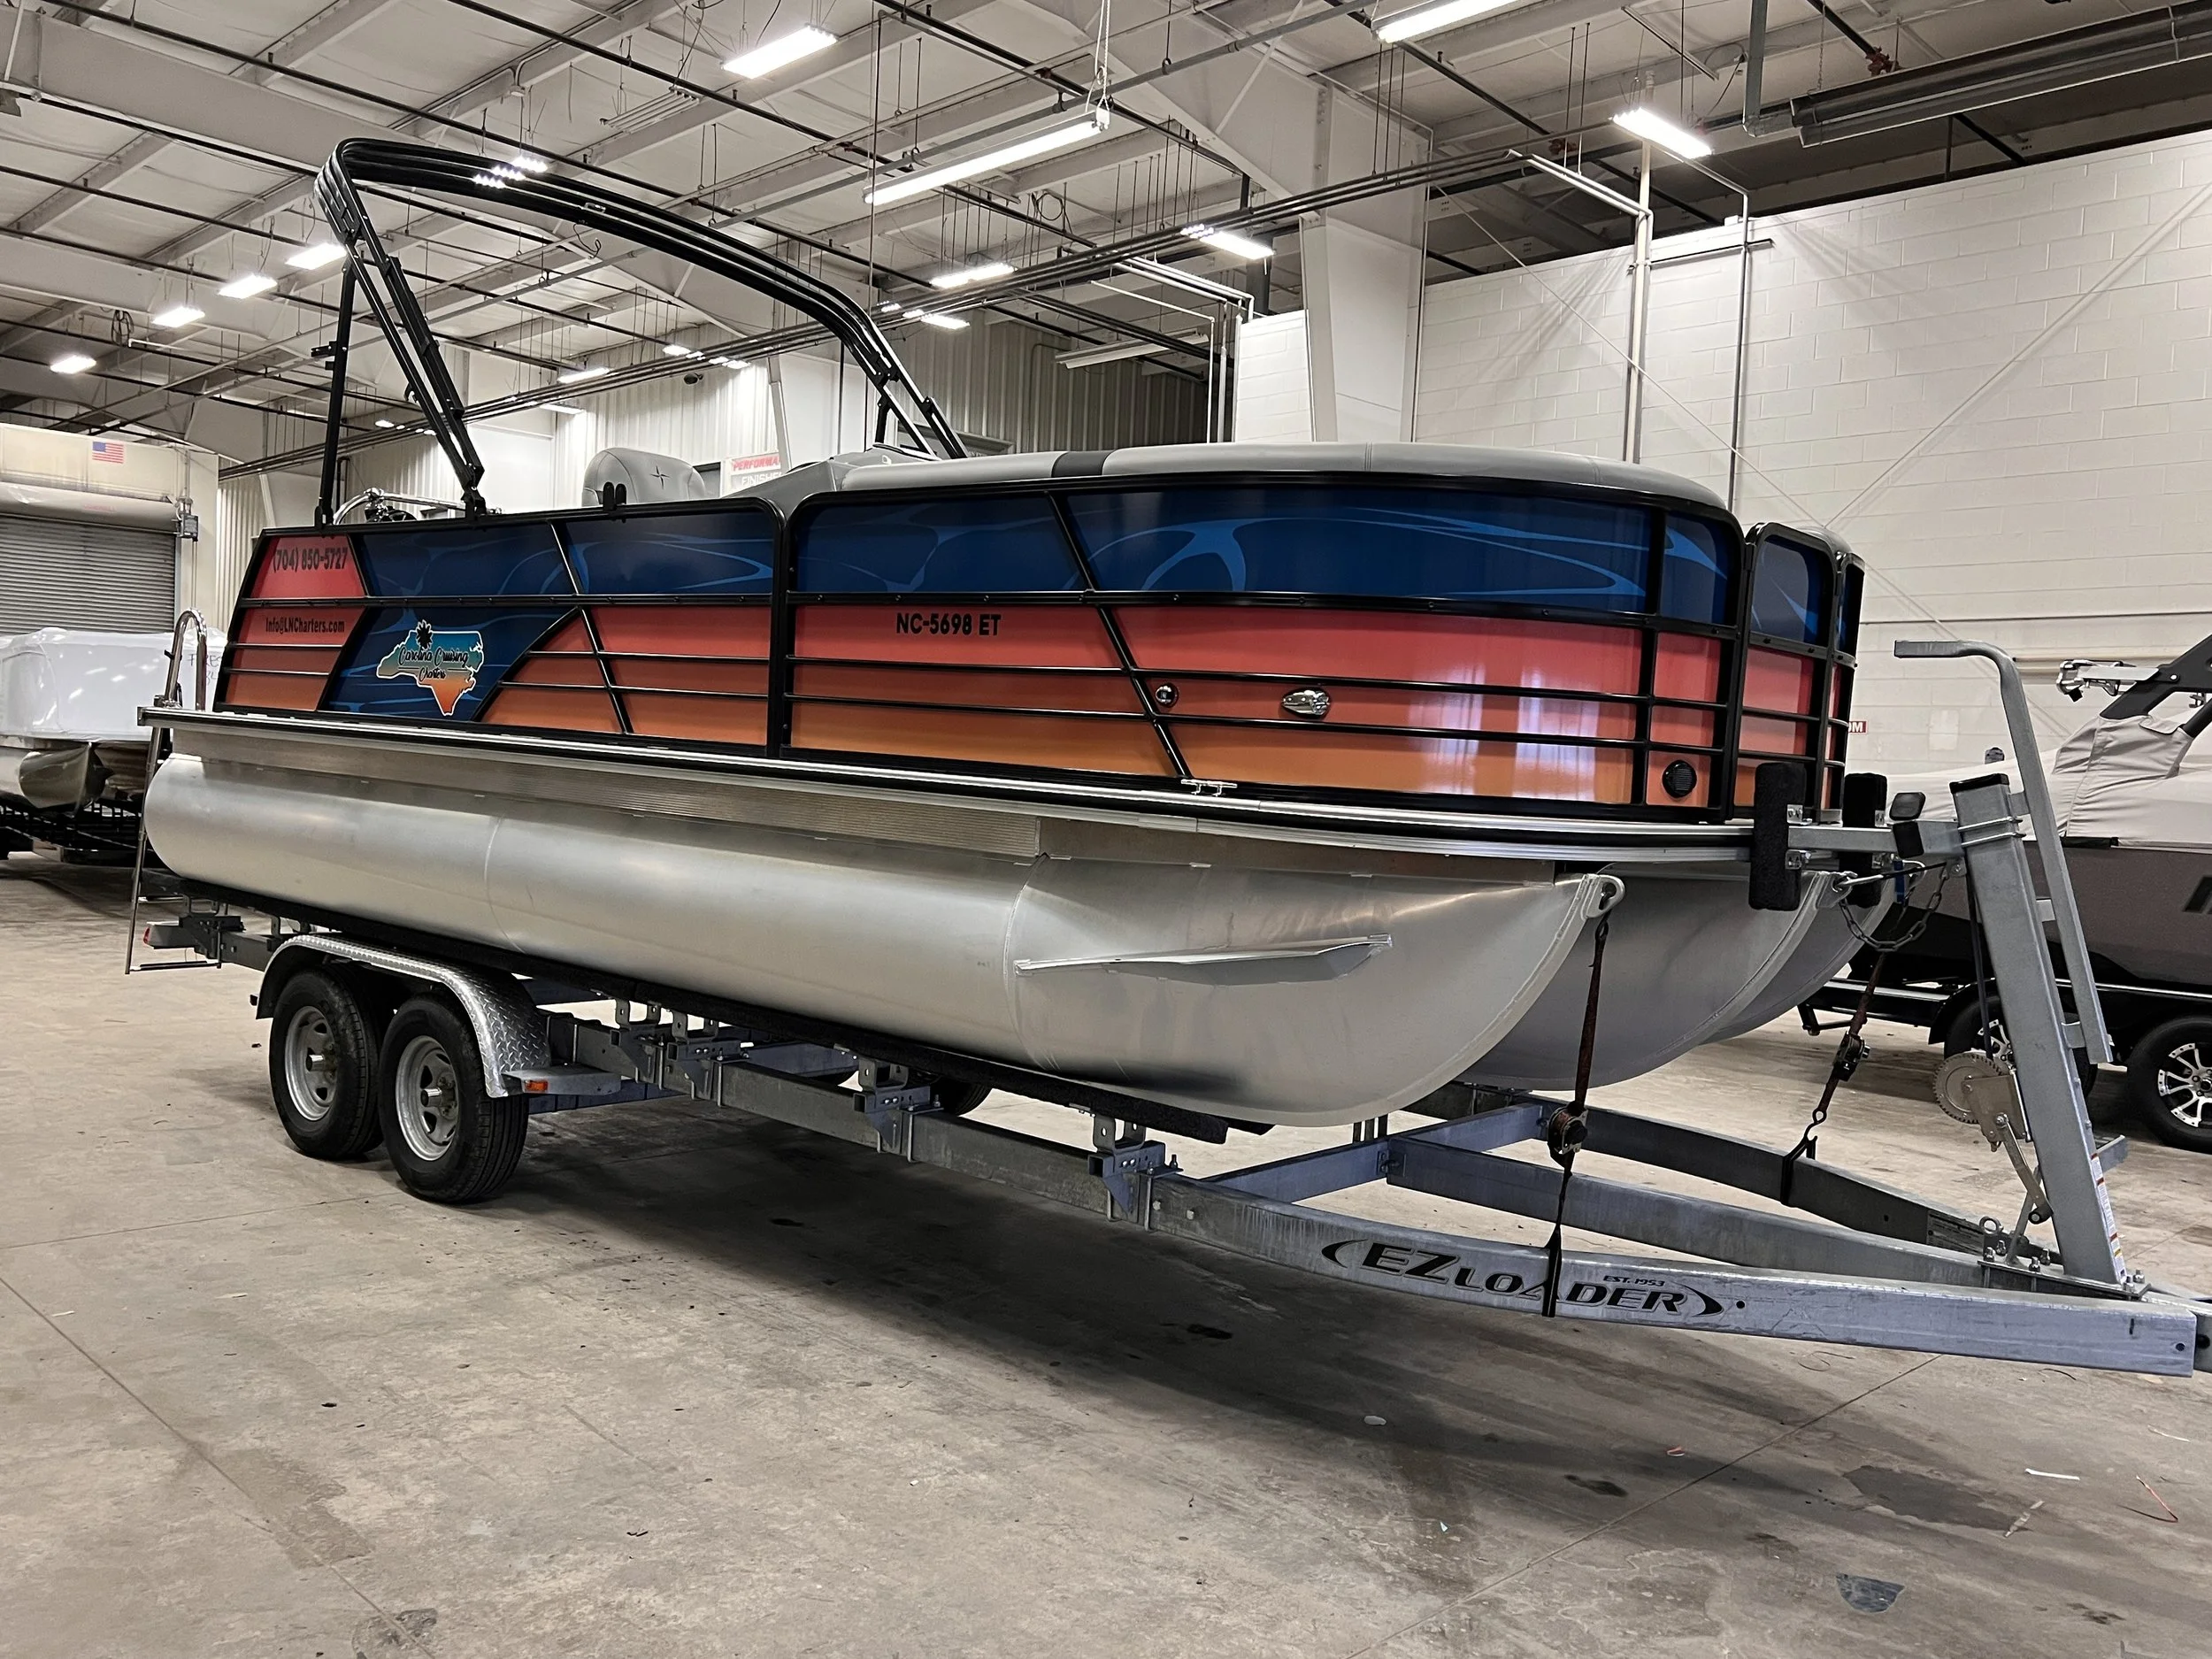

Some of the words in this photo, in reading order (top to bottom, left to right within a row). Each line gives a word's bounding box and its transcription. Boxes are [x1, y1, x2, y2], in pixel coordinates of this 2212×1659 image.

[273, 548, 299, 573] (704)
[302, 547, 349, 571] 850-5727
[895, 612, 972, 635] NC-5698
[979, 613, 1002, 636] ET
[398, 646, 433, 665] Carolina
[434, 646, 469, 668] Cruising
[419, 666, 447, 681] Charters
[1602, 1274, 1632, 1284] EST.
[1634, 1277, 1666, 1287] 1953
